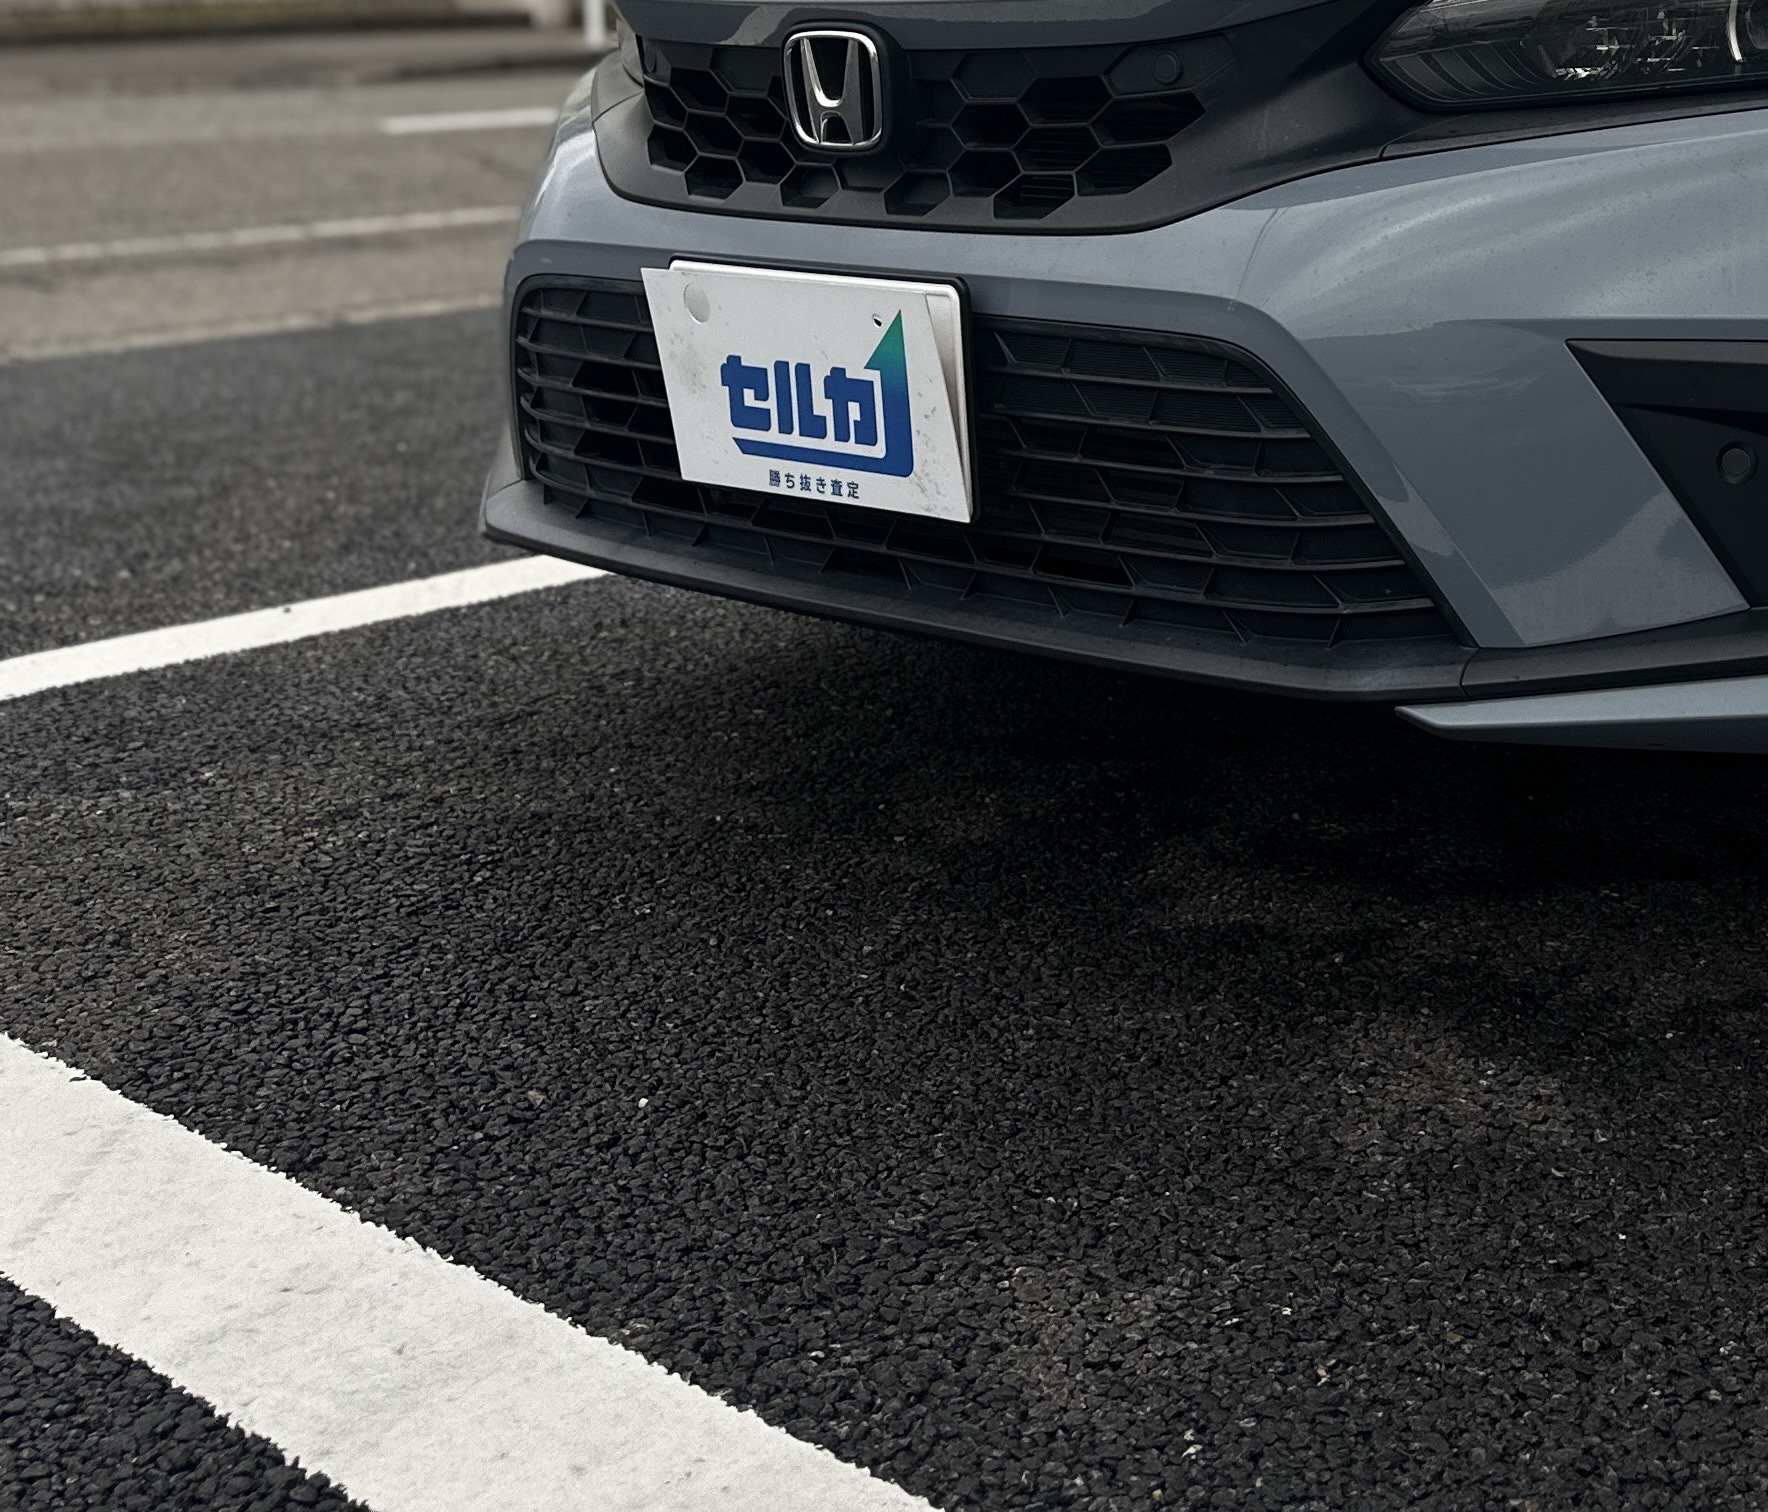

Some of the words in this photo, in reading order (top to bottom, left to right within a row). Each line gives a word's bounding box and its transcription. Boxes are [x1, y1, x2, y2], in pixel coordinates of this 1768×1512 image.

[720, 354, 878, 447] セルカ
[768, 468, 860, 500] 勝ち抜き査定
